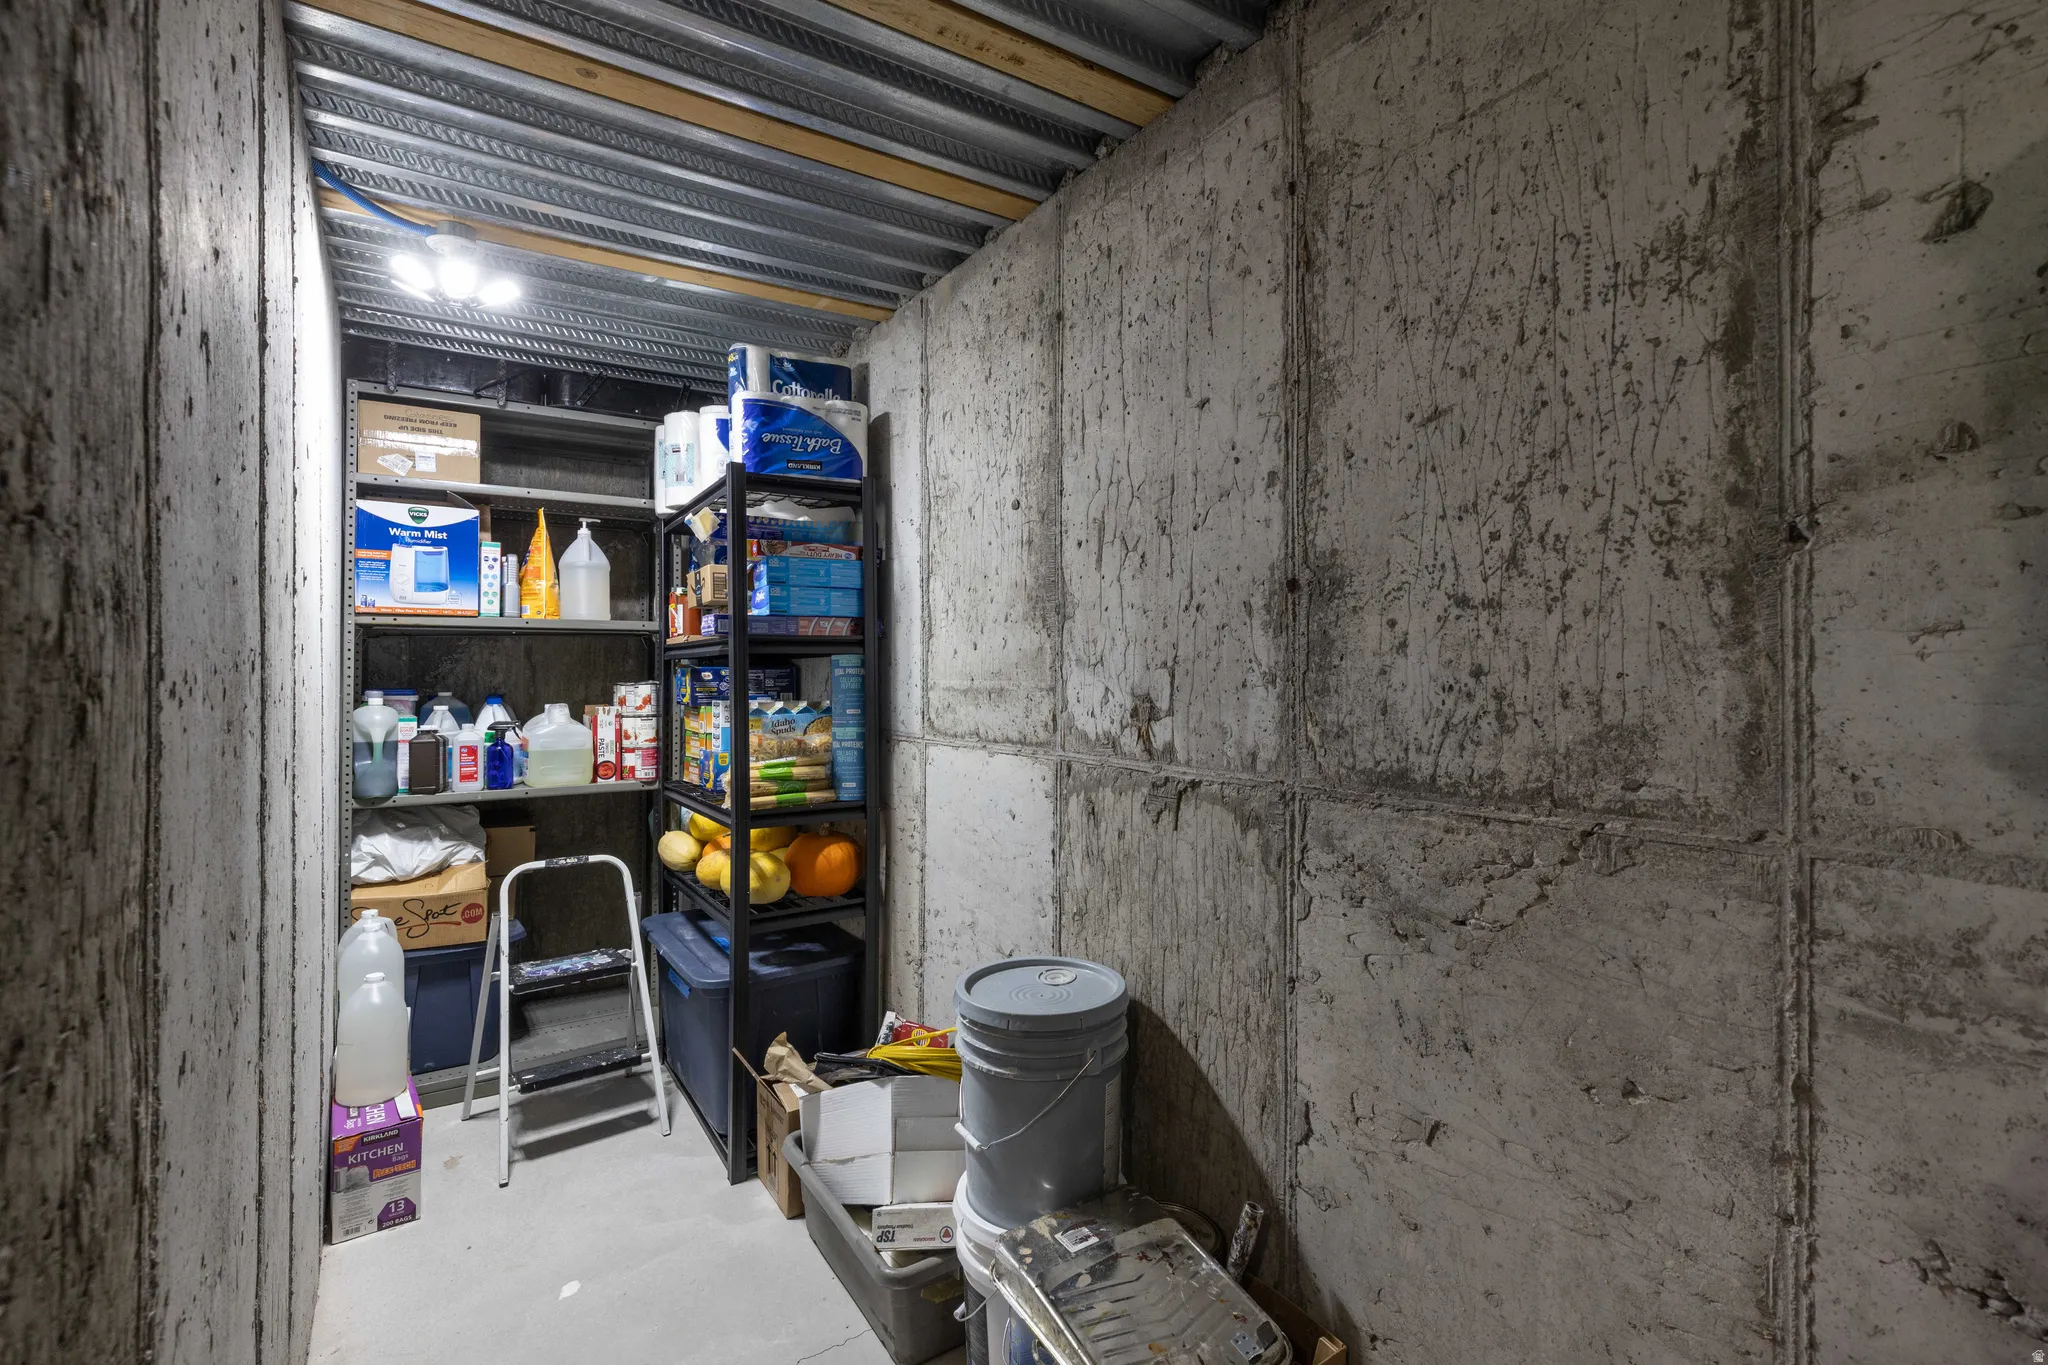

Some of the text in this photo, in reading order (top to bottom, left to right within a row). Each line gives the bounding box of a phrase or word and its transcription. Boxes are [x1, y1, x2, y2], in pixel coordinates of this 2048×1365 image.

[384, 414, 418, 423] FREEZING
[762, 432, 842, 455] Bath Tissue
[788, 462, 821, 470] KIRKLAND
[389, 527, 448, 540] Warm Mist
[771, 718, 796, 728] Idaho
[770, 725, 796, 735] Spuds
[403, 899, 461, 938] Spot
[461, 909, 483, 919] .COM
[363, 1129, 399, 1142] KIRKLAND
[348, 1143, 404, 1164] KITCHEN
[392, 1154, 409, 1163] Bags
[389, 1200, 405, 1213] 13
[382, 1214, 412, 1228] 200 BAGS
[876, 1230, 896, 1243] TSP
